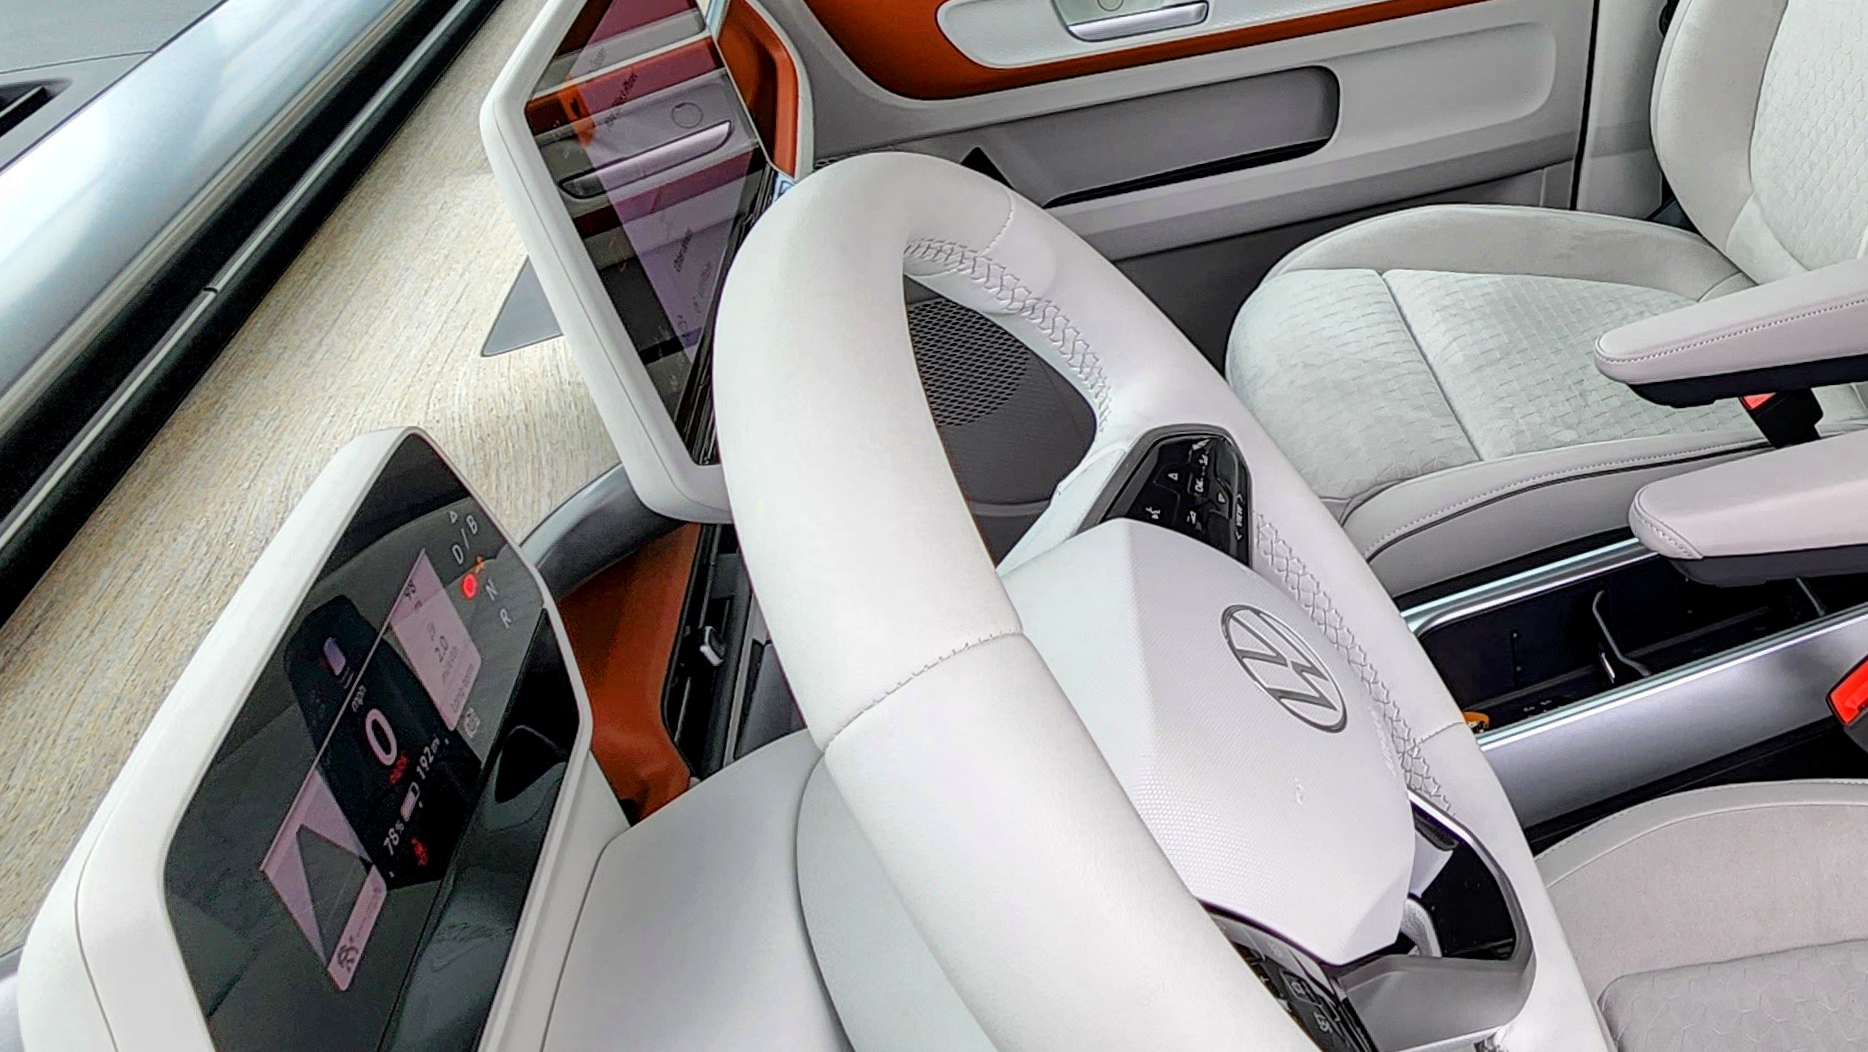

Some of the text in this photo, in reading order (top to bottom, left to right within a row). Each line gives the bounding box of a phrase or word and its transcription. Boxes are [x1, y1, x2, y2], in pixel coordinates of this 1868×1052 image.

[485, 579, 498, 601] N
[500, 608, 512, 629] R
[434, 635, 449, 663] 2.0
[365, 708, 398, 766] 0
[1313, 1011, 1333, 1034] SET
